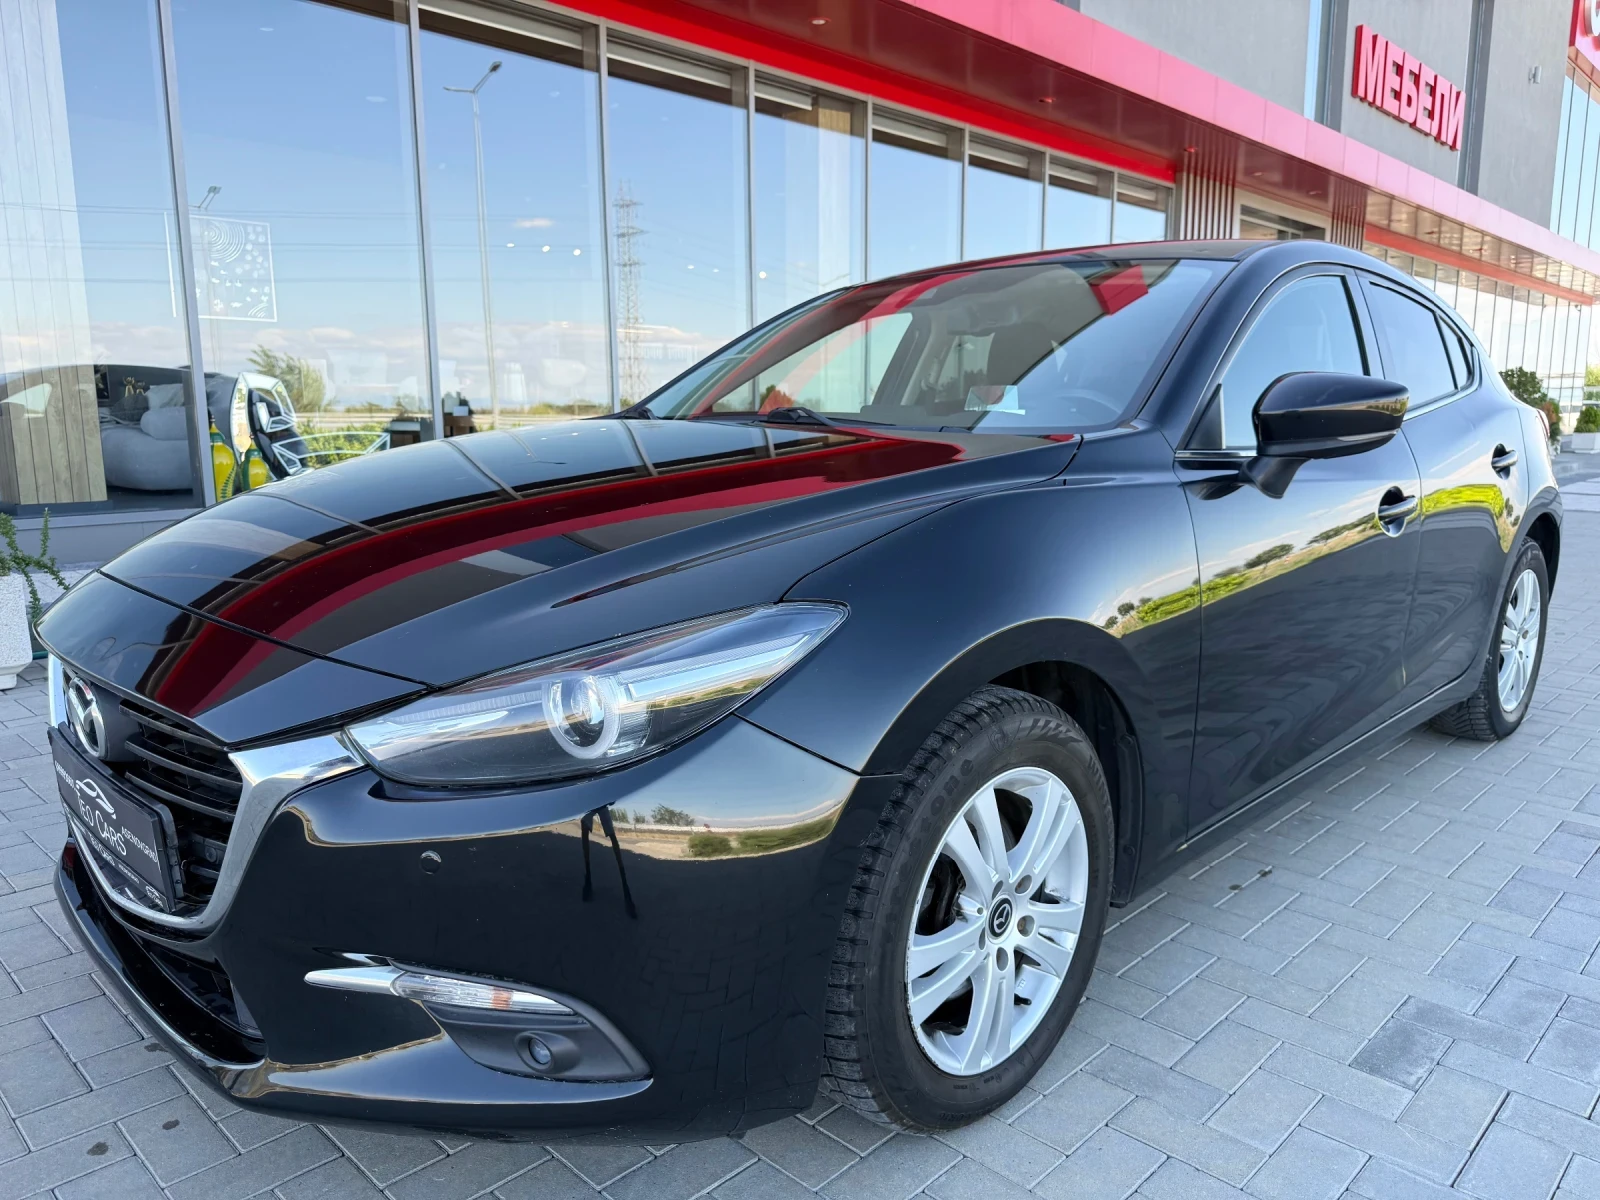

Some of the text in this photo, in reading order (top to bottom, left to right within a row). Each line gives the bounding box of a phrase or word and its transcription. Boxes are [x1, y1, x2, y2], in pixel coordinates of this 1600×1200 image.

[1352, 24, 1467, 151] МЕБЕЛИ
[75, 788, 95, 828] TEO
[95, 810, 127, 856] CARS
